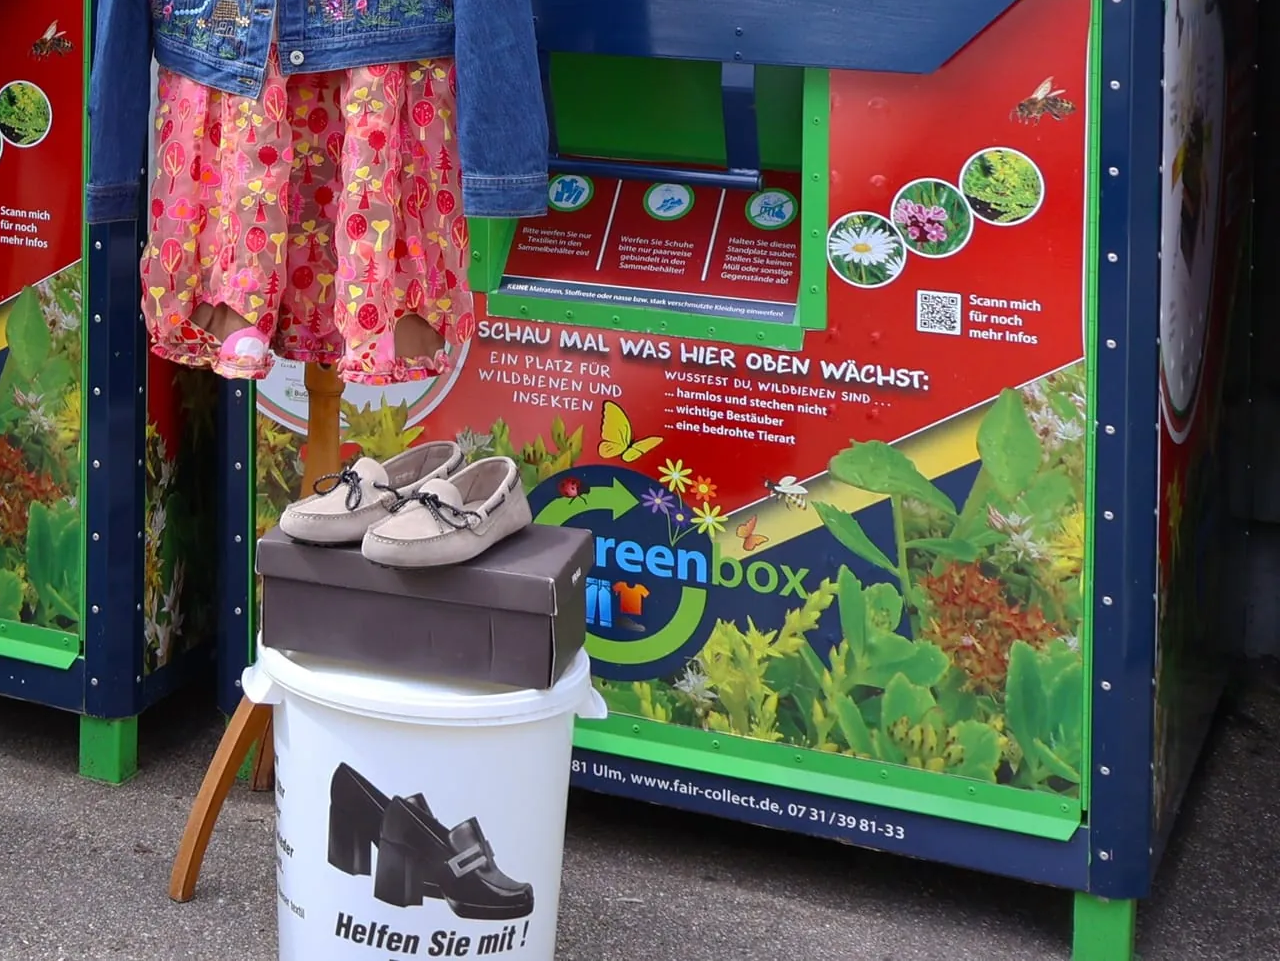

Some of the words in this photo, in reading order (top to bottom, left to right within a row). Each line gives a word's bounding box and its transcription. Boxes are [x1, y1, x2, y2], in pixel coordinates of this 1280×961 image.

[0, 205, 27, 218] Scann
[28, 209, 51, 220] mich
[0, 219, 13, 230] für
[14, 222, 37, 233] noch
[522, 226, 540, 235] Bitte
[540, 228, 566, 237] werfen
[566, 230, 578, 239] Sie
[0, 234, 23, 246] mehr
[25, 237, 48, 249] Infos
[517, 243, 575, 256] Sammelbehälter
[527, 235, 558, 245] Textilien
[567, 239, 582, 248] den
[620, 235, 649, 245] Werfen
[650, 237, 663, 246] Sie
[664, 239, 695, 249] Schuhe
[728, 237, 755, 246] Halten
[756, 239, 769, 248] Sie
[769, 240, 797, 250] diesen
[618, 244, 637, 252] bitte
[652, 248, 693, 258] paarweise
[726, 245, 768, 256] Standplatz
[619, 253, 660, 264] gebündelt
[661, 256, 669, 264] in
[670, 257, 686, 266] den
[725, 254, 752, 263] Stellen
[753, 256, 765, 265] Sie
[765, 257, 793, 267] keinen
[618, 261, 685, 276] Sammelbehälter!
[722, 262, 740, 271] Müll
[741, 265, 759, 273] oder
[760, 266, 793, 277] sonstige
[720, 271, 774, 283] Gegenstände
[775, 277, 789, 285] ab!
[506, 283, 529, 291] KEINE
[529, 284, 564, 295] Matratzen,
[564, 288, 595, 298] Stoffreste
[596, 292, 612, 300] oder
[613, 294, 632, 302] nasse
[633, 295, 648, 303] bzw.
[650, 298, 666, 306] stark
[667, 300, 713, 310] verschmutzte
[714, 303, 745, 314] Kleidung
[746, 306, 784, 317] einwerfen!
[969, 294, 1007, 309] Scann
[1009, 298, 1041, 312] mich
[968, 310, 988, 322] für
[990, 313, 1023, 327] noch
[968, 328, 1003, 341] mehr
[1005, 330, 1038, 345] Infos
[478, 320, 551, 345] SCHAU
[560, 329, 610, 353] MAL
[620, 336, 671, 360] WAS
[680, 342, 737, 369] HIER
[745, 352, 811, 376] OBEN
[820, 359, 930, 391] WÄCHST:
[489, 350, 518, 366] EIN
[524, 354, 573, 373] PLATZ
[580, 361, 611, 379] FÜR
[478, 367, 583, 392] WILDBIENEN
[589, 382, 623, 397] UND
[664, 370, 729, 387] WUSSTEST
[733, 378, 753, 392] DU,
[757, 381, 836, 400] WILDBIENEN
[841, 391, 871, 404] SIND
[512, 390, 594, 412] INSEKTEN
[676, 387, 722, 403] harmlos
[724, 393, 747, 406] und
[749, 395, 795, 412] stechen
[797, 402, 828, 416] nicht
[676, 403, 724, 421] wichtige
[726, 410, 784, 427] Bestäuber
[676, 421, 701, 432] eine
[702, 424, 755, 440] bedrohte
[756, 429, 796, 445] Tierart
[593, 536, 811, 600] reenbox
[593, 762, 626, 783] Ulm,
[630, 772, 783, 815] www.fair-collect.de,
[335, 911, 420, 955] Helfen
[428, 930, 470, 957] Sie
[477, 925, 516, 955] mit
